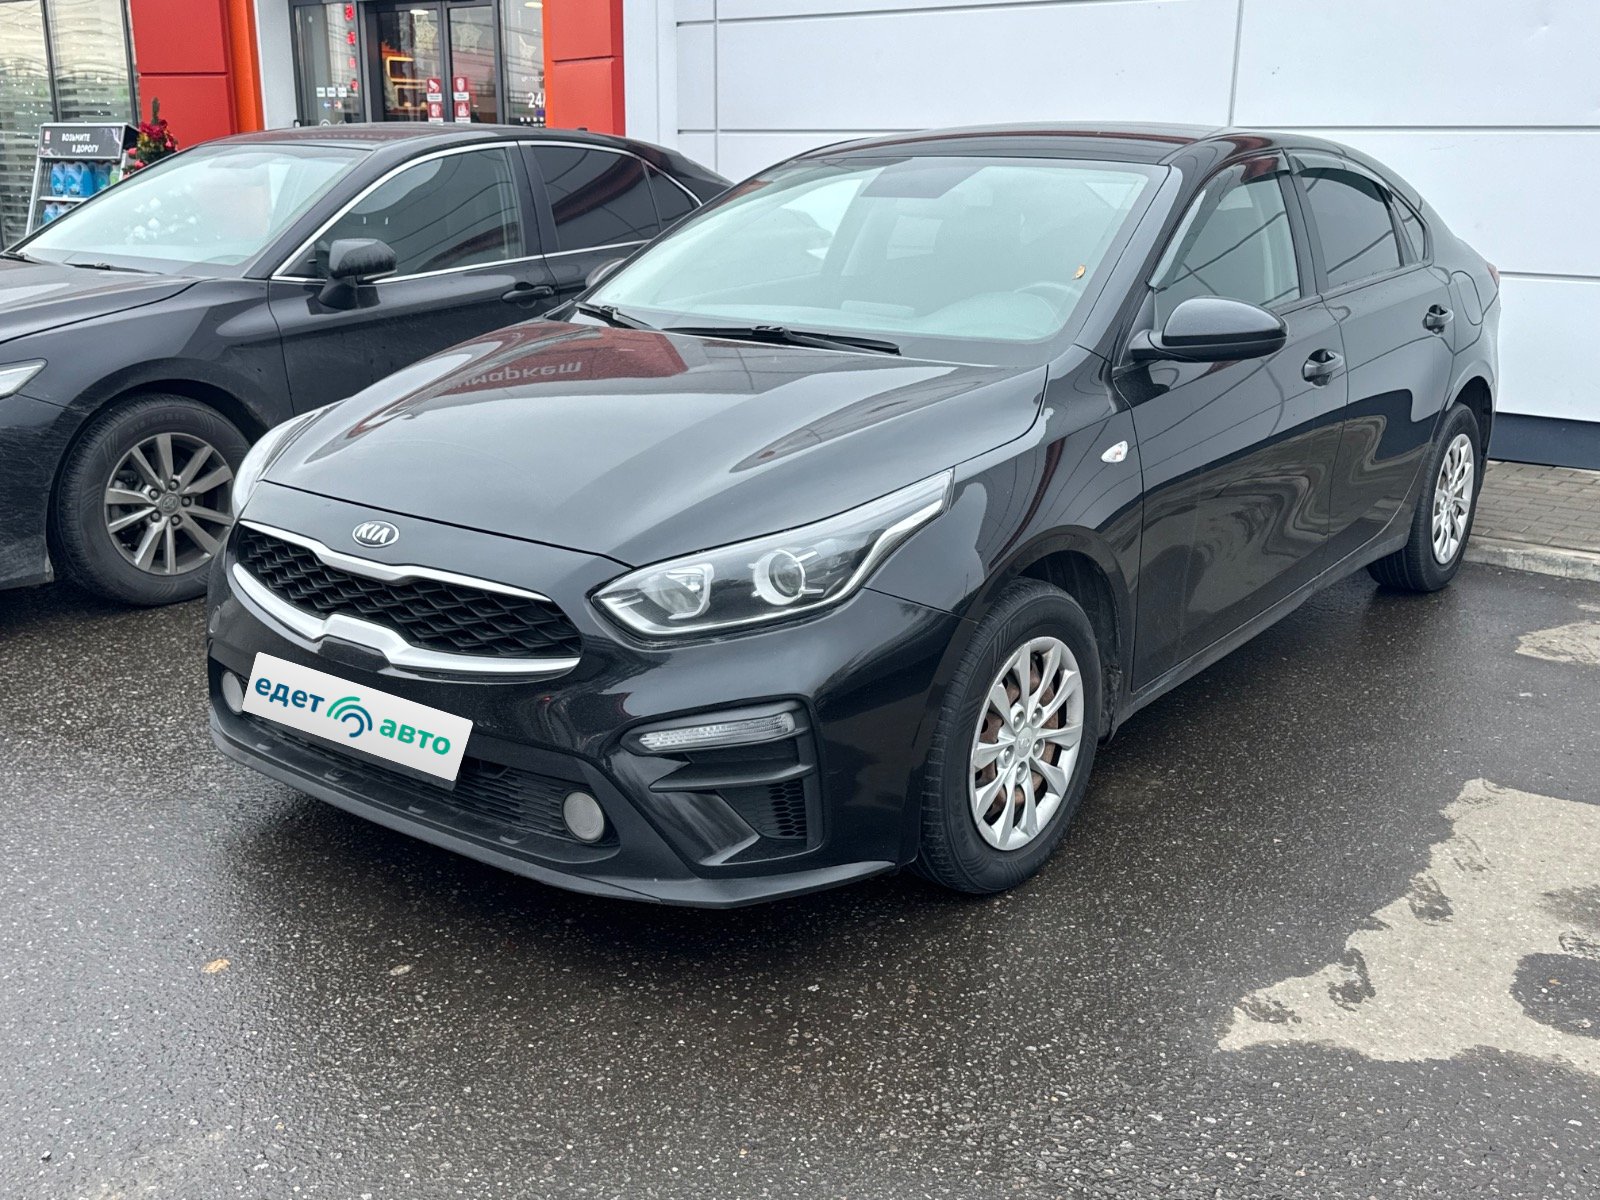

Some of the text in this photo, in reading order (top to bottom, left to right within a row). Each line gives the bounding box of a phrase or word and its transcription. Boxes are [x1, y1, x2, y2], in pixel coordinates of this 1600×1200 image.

[61, 133, 90, 142] ВОЗЬМИТЕ
[76, 144, 99, 153] ДОРОГУ
[356, 523, 390, 544] KIA
